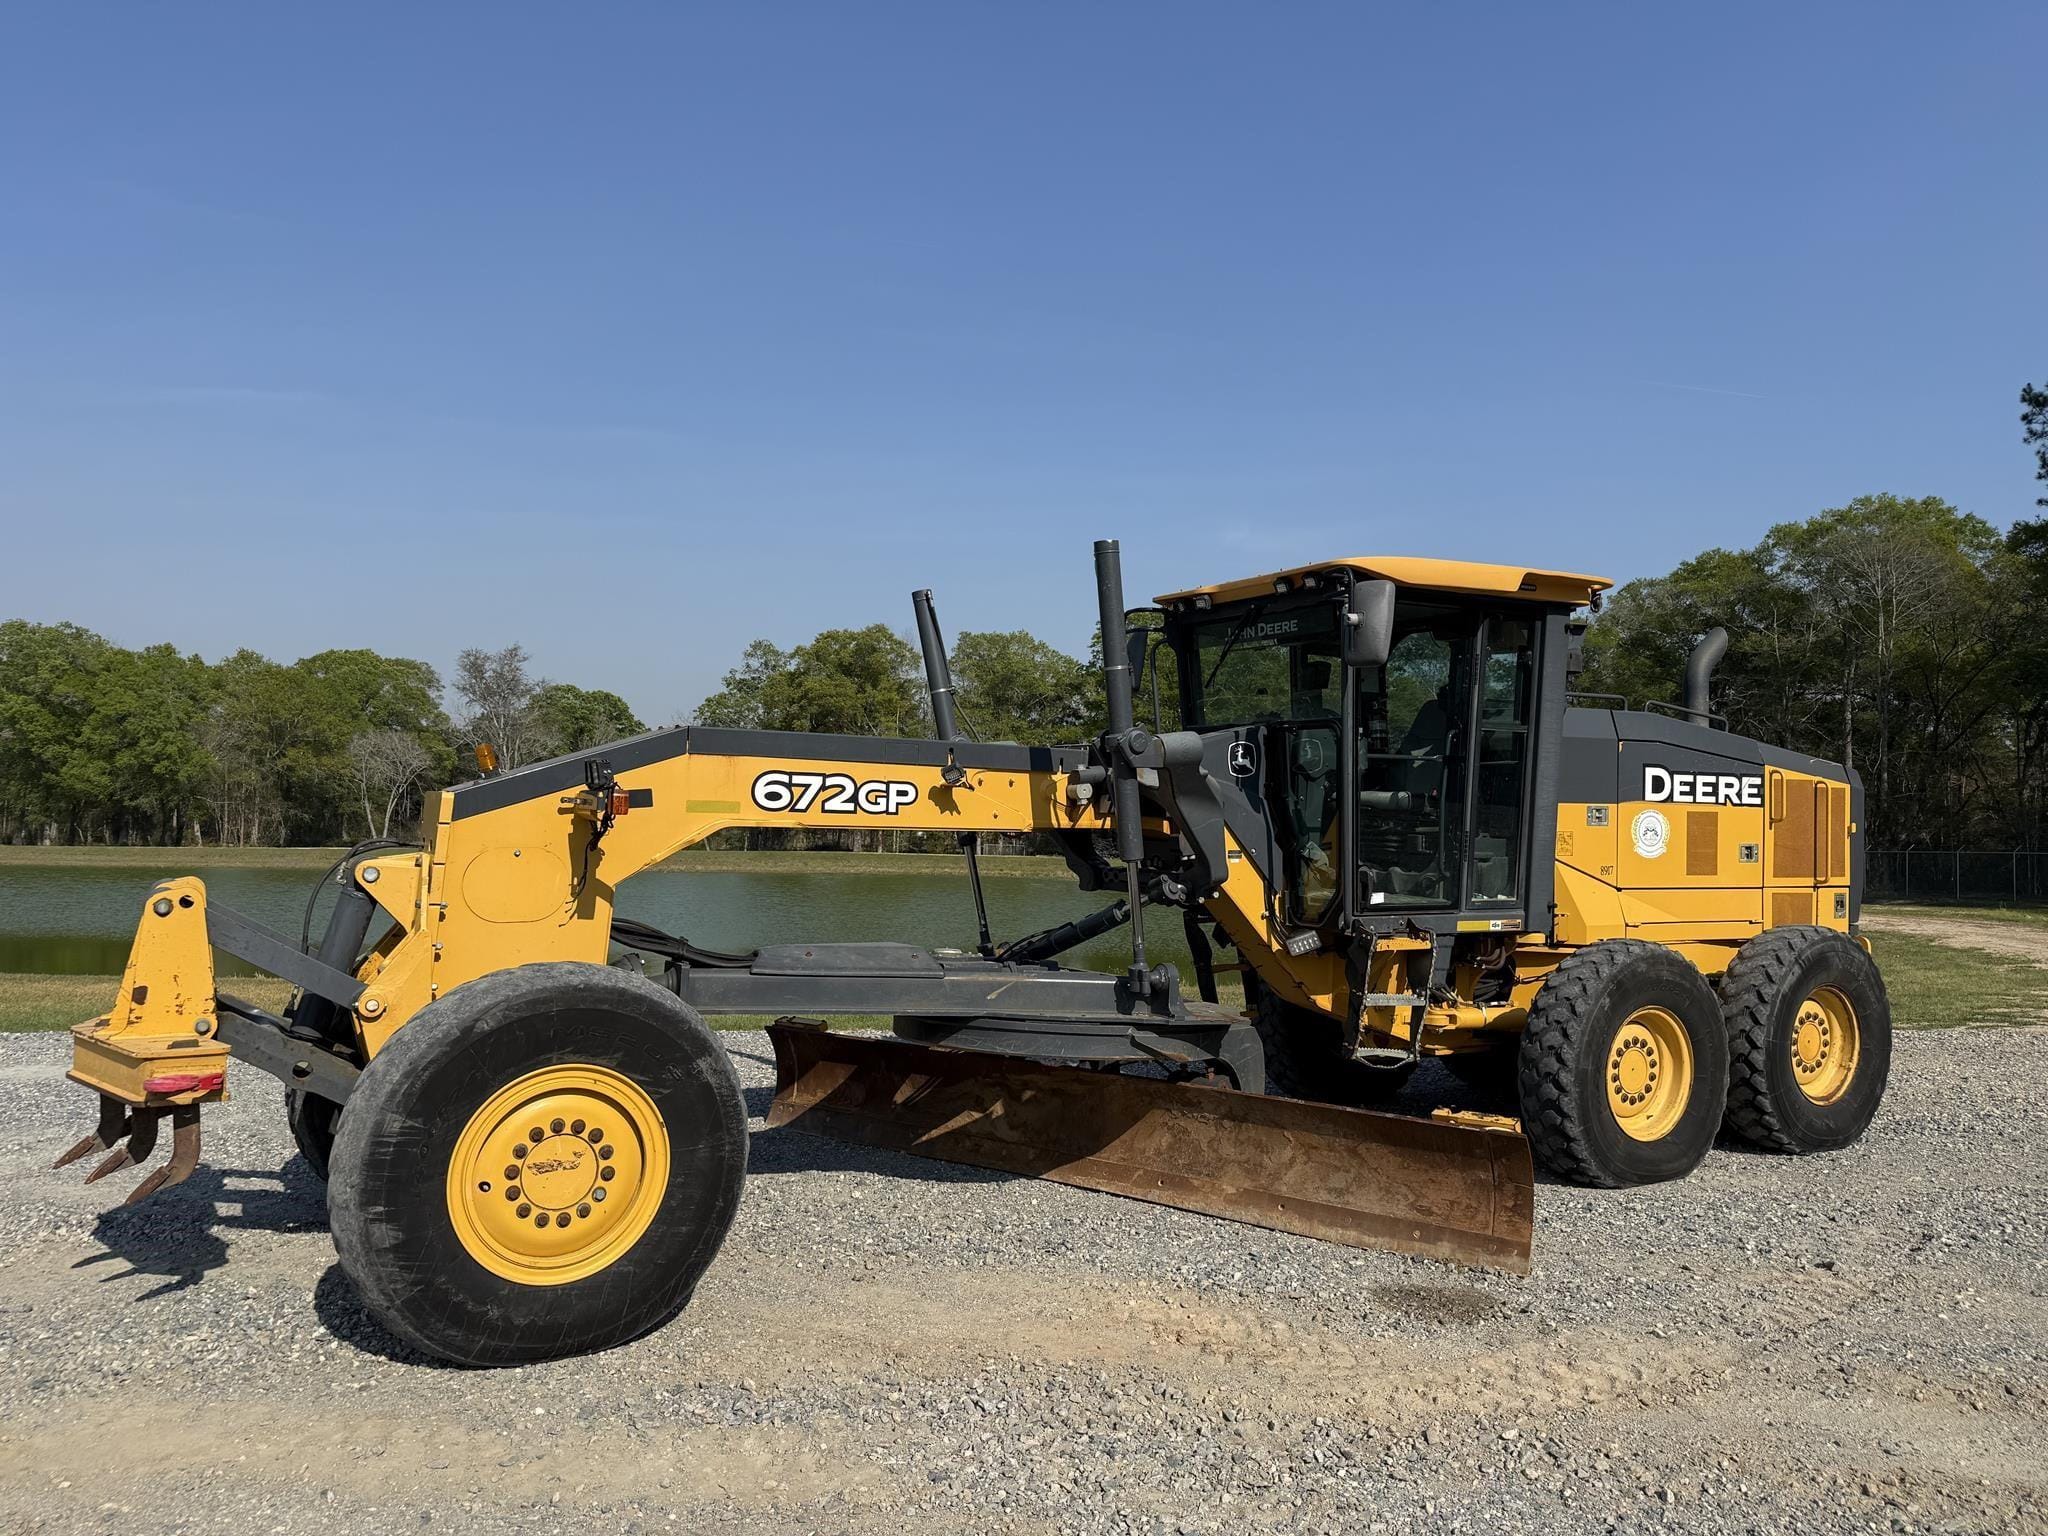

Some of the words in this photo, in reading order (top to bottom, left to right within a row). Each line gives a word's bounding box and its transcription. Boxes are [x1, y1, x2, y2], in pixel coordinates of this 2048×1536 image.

[1258, 620, 1298, 636] DEERE
[752, 771, 917, 815] 672GP
[1644, 766, 1762, 805] DEERE
